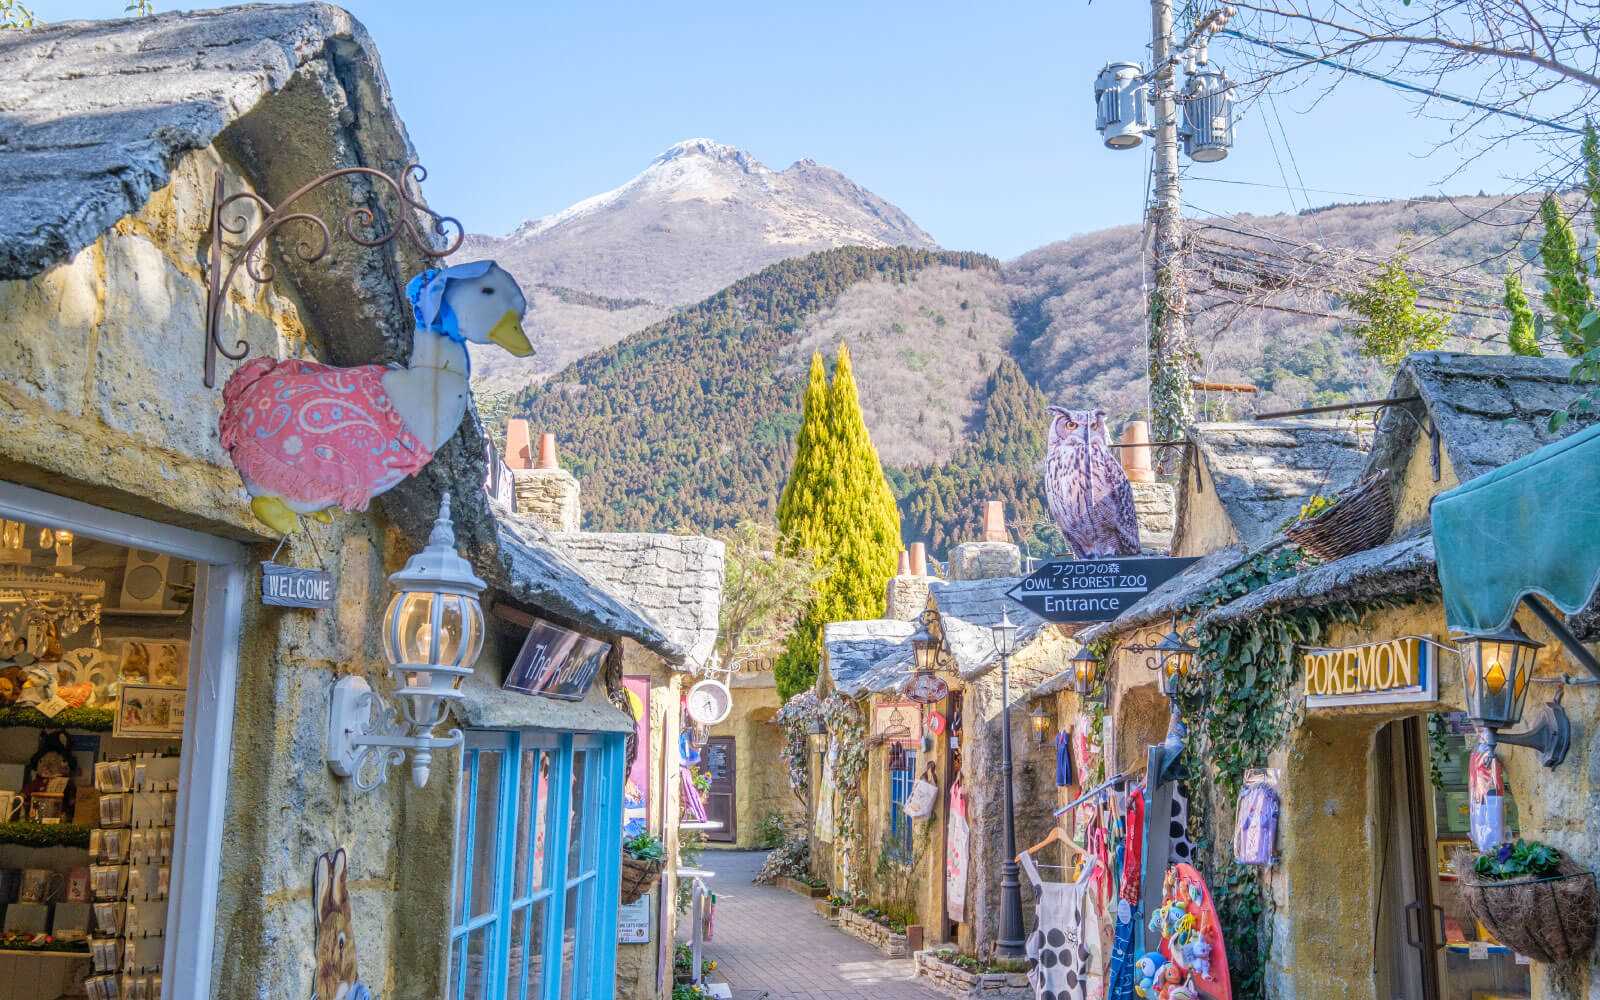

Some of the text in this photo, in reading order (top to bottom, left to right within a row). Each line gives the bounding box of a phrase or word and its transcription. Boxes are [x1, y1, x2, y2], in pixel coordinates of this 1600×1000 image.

[1052, 563, 1120, 576] フクロウの森
[269, 575, 330, 601] WELCOME
[1072, 576, 1116, 588] FOREST
[1119, 575, 1147, 587] ZOO
[1044, 596, 1120, 612] Entrance
[525, 644, 552, 682] The
[1303, 638, 1412, 696] POKEMON
